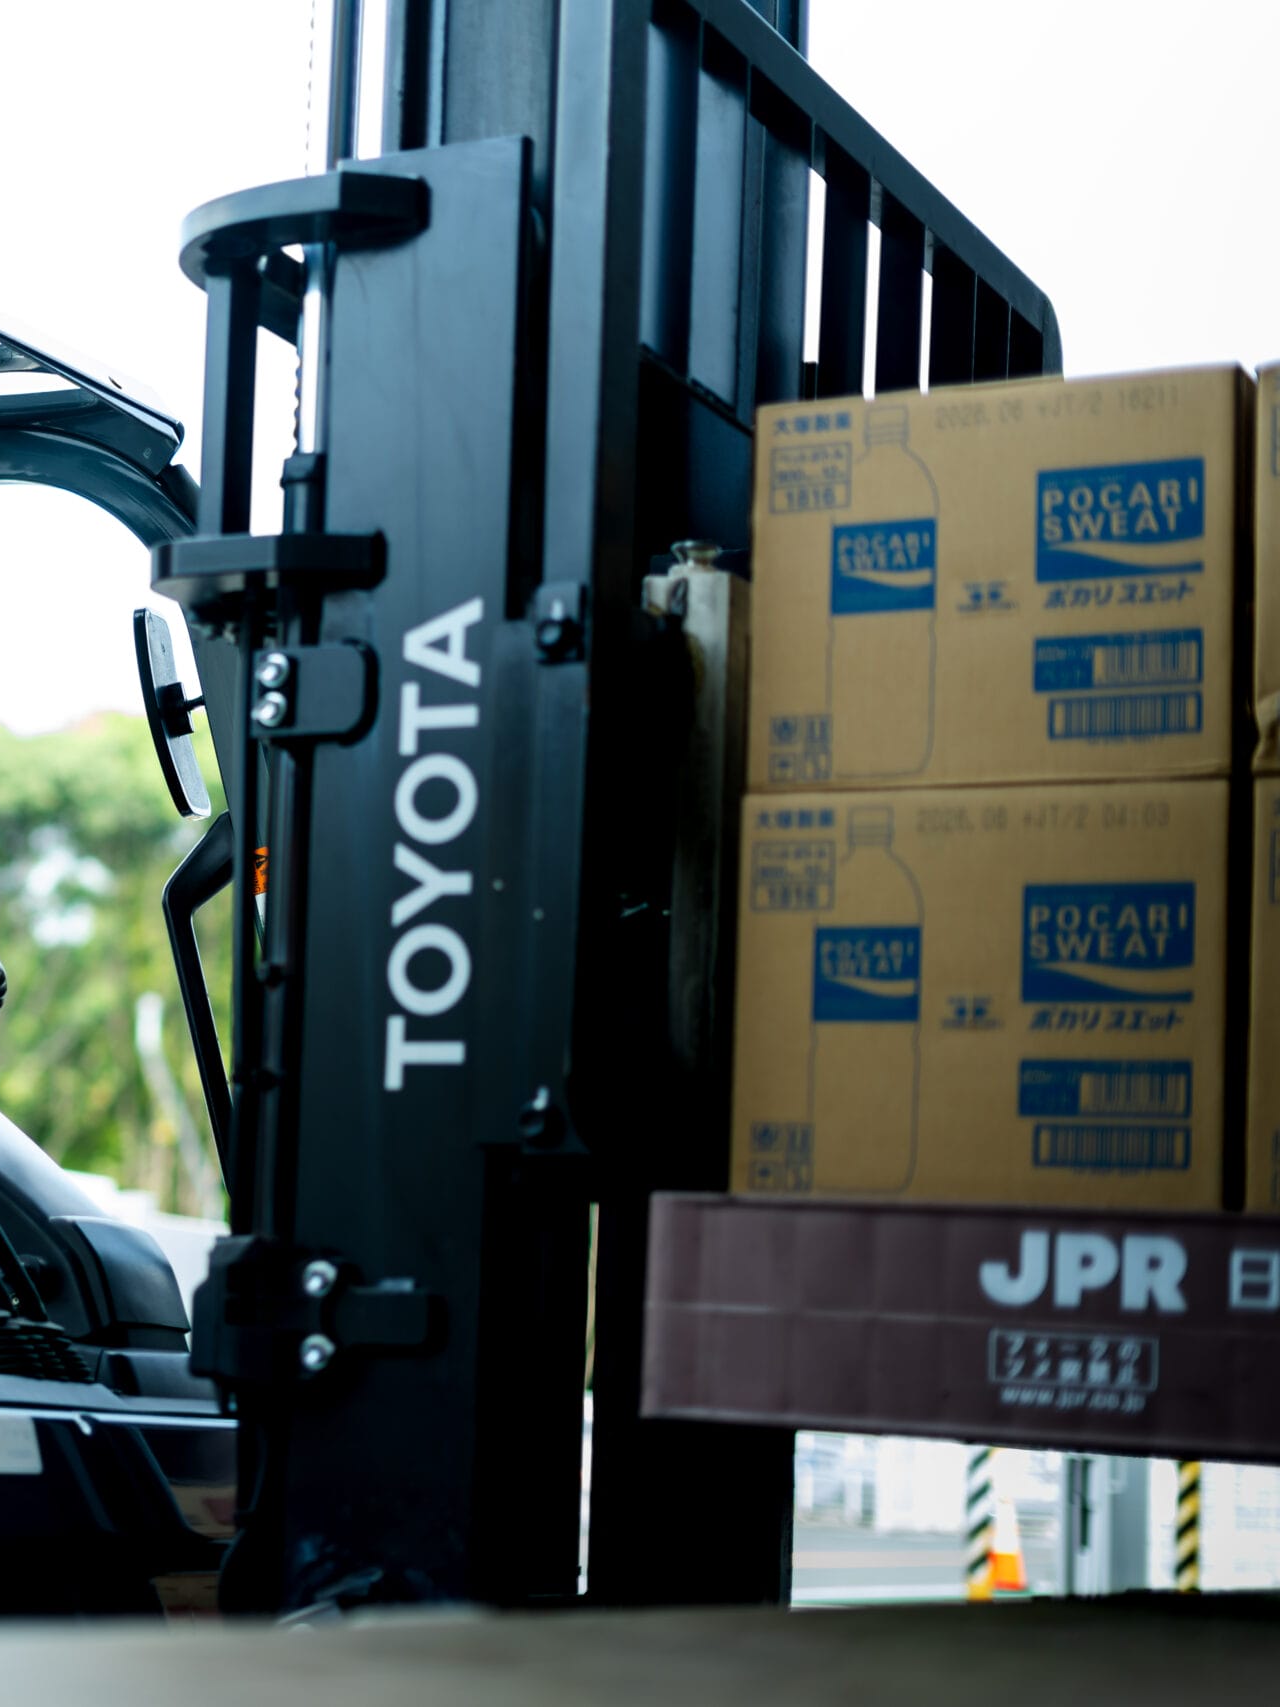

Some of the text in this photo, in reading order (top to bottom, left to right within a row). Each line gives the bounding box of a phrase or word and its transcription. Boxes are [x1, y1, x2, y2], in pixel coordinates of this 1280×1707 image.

[1042, 476, 1198, 514] POCARI
[1043, 508, 1182, 541] SWEAT
[838, 531, 930, 555] POCARI
[838, 549, 918, 573] SWEAT
[384, 597, 484, 1091] TOYOTA
[1030, 904, 1188, 931] POCARI
[821, 940, 915, 959] POCARI
[1030, 931, 1170, 960] SWEAT
[822, 956, 904, 977] SWEAT
[979, 1229, 1189, 1313] JPR
